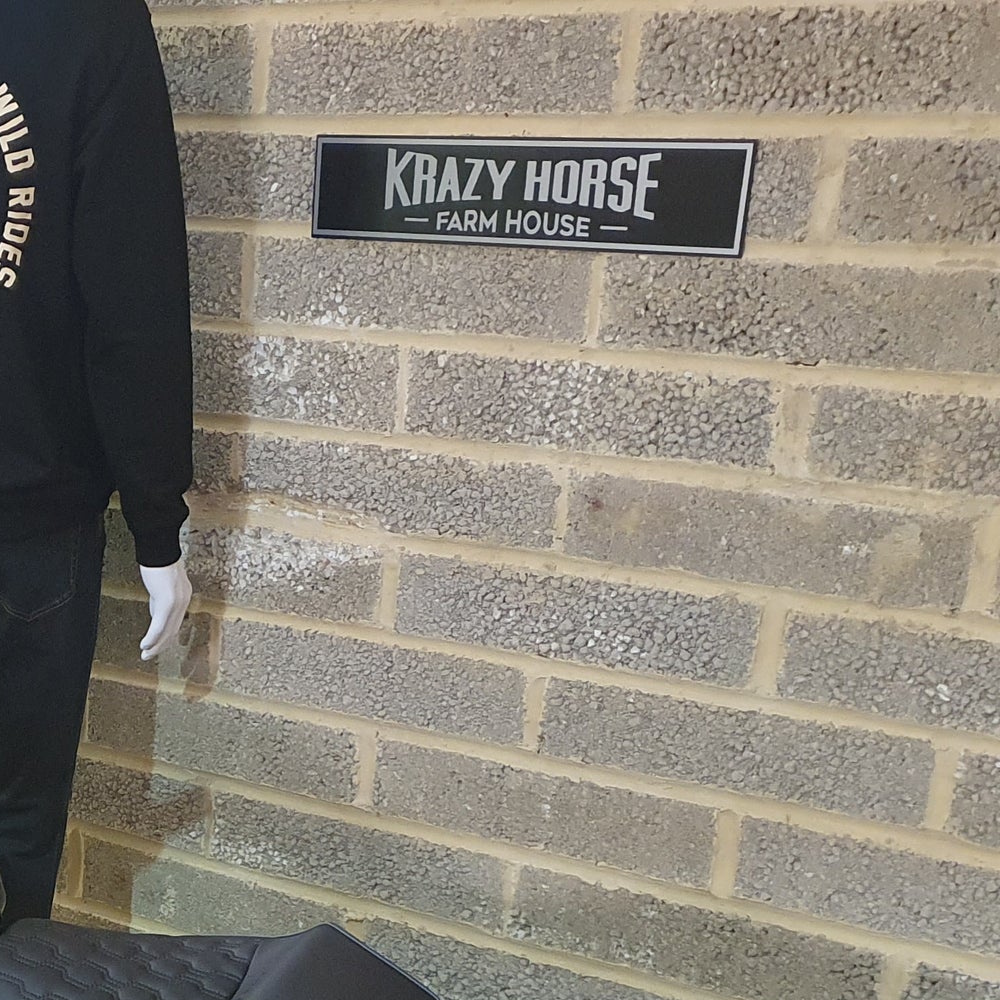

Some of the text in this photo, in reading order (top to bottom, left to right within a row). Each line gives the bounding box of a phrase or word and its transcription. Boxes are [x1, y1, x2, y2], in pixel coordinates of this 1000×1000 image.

[384, 147, 662, 221] KRAZY HORSE
[436, 209, 591, 238] FARM HOUSE
